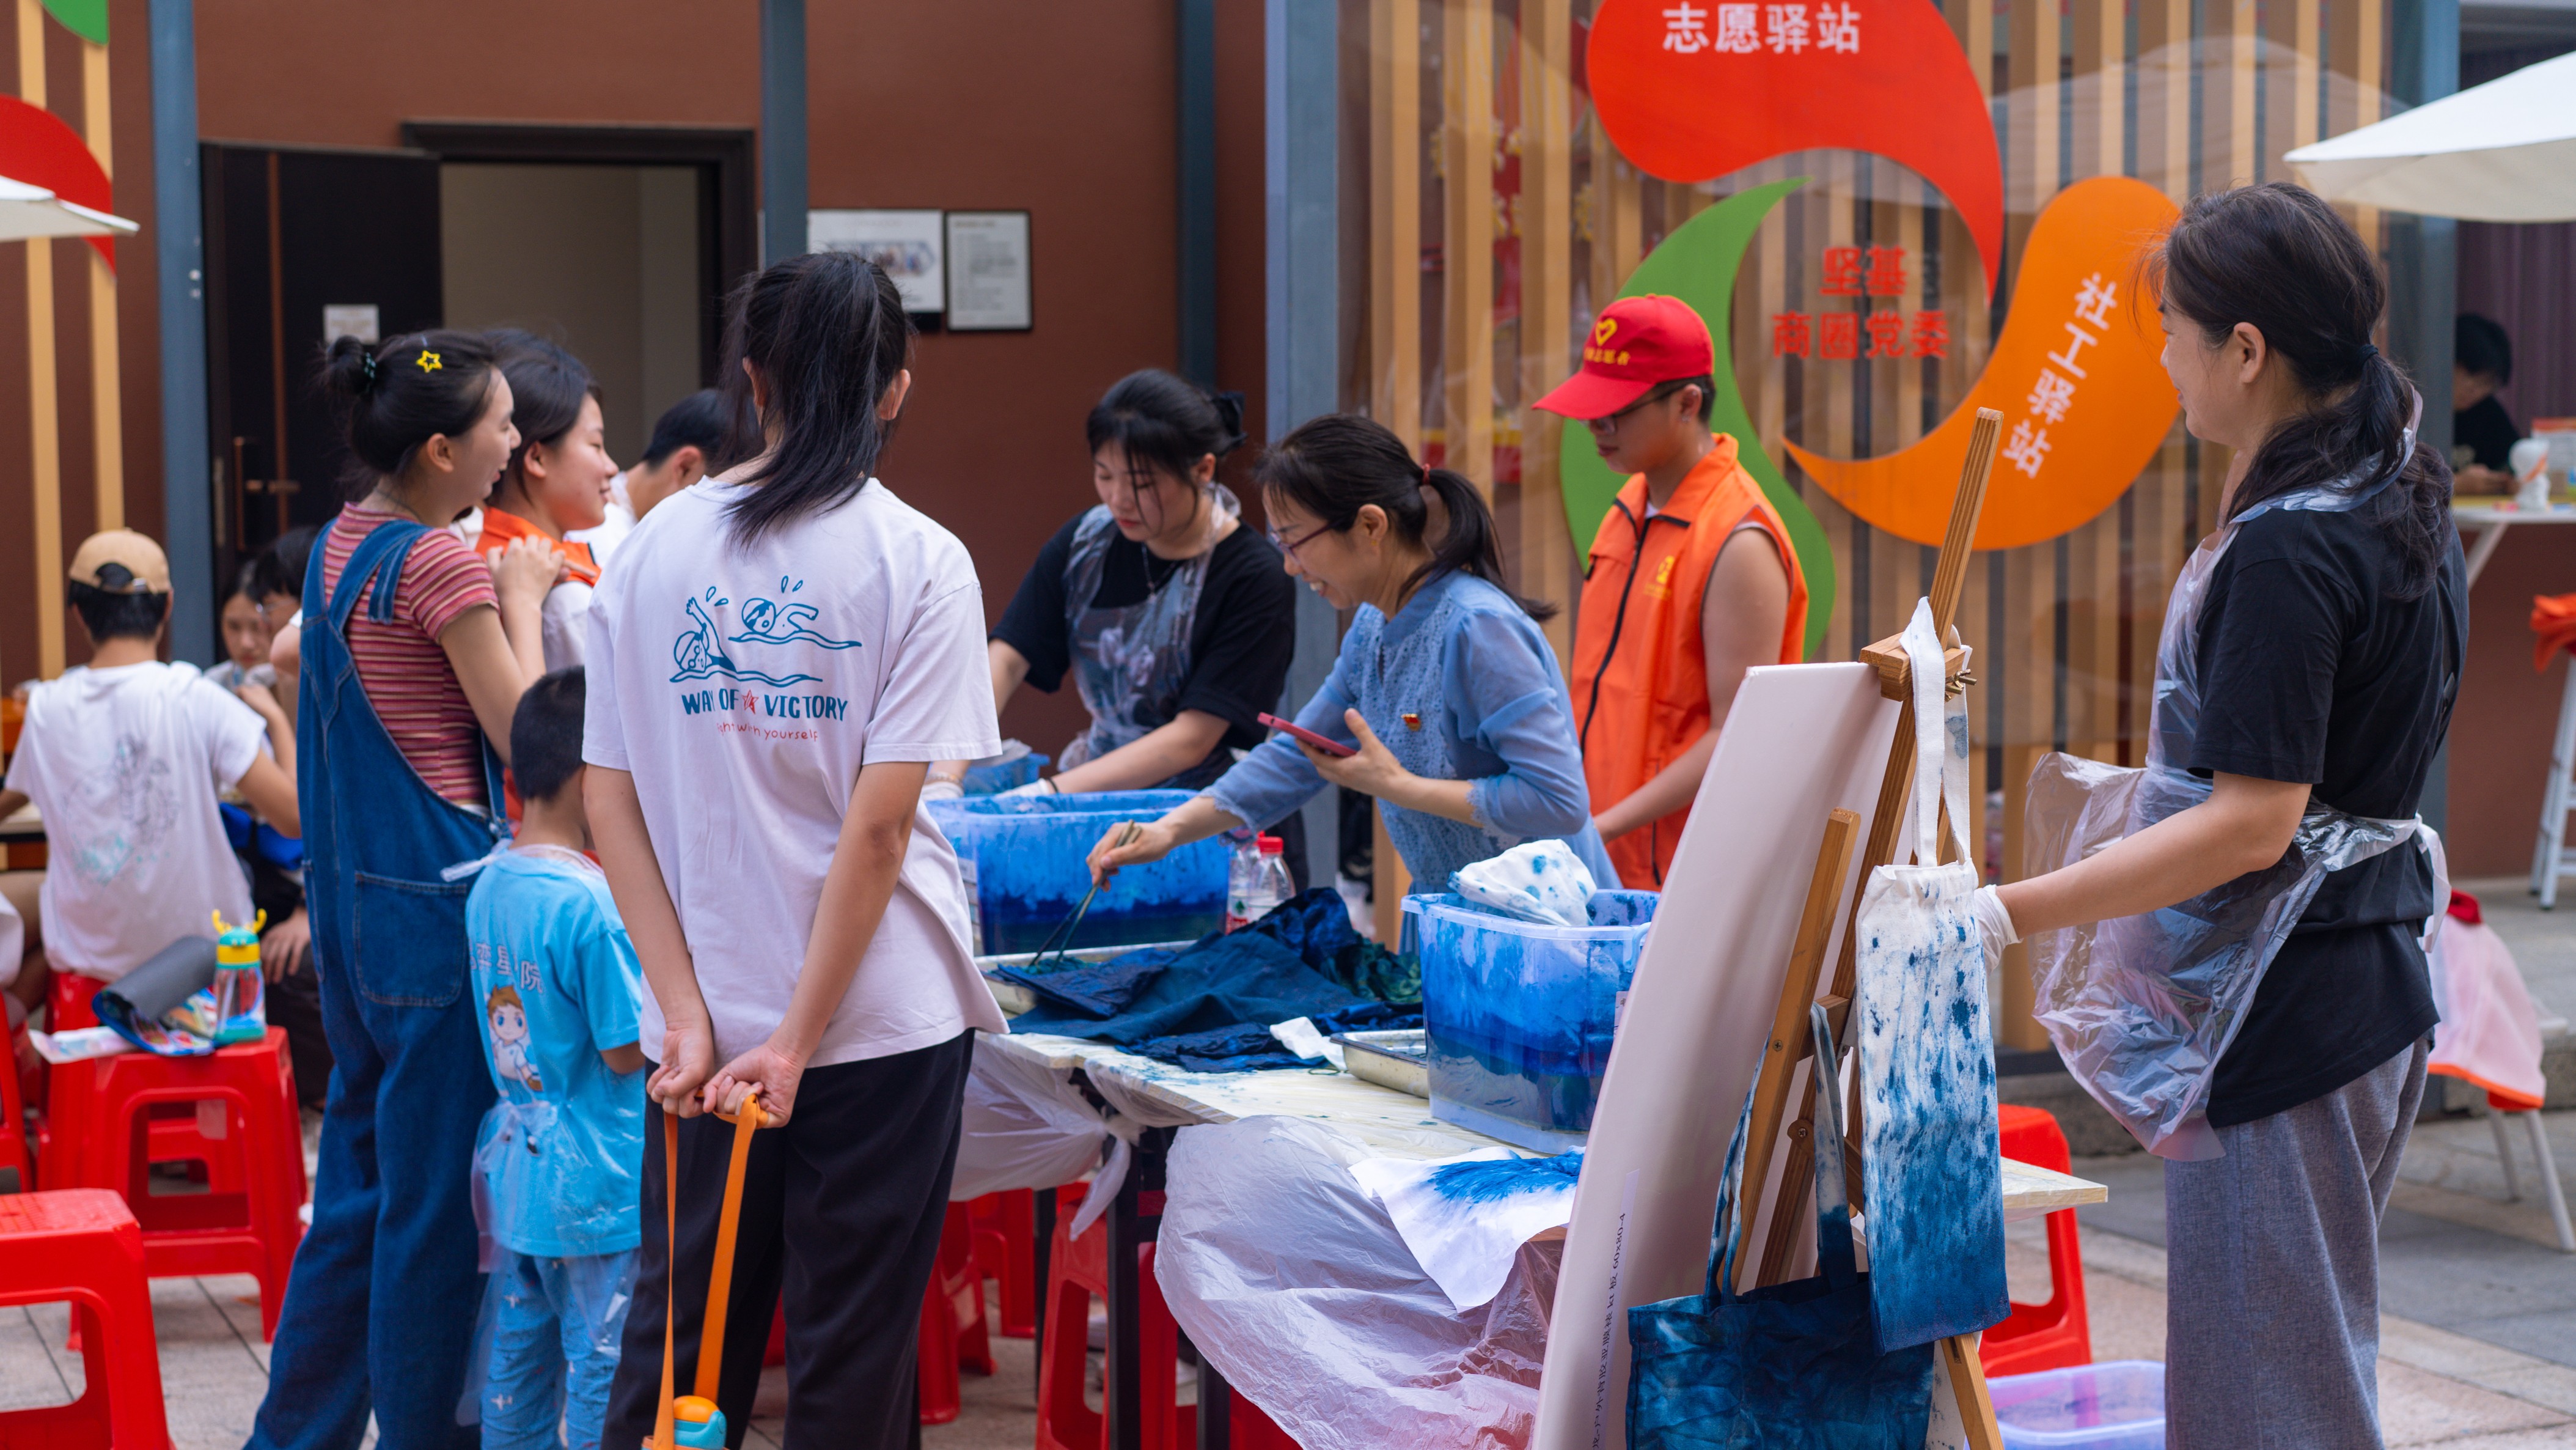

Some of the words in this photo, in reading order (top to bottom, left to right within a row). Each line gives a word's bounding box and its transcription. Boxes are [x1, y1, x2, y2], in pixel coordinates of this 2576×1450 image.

[1662, 2, 1862, 54] 志愿驿站
[1819, 246, 1907, 298] 坚基
[1772, 311, 1950, 359] 商圈党委
[2002, 273, 2118, 479] 社工驿站
[681, 691, 715, 715] WAY
[719, 688, 739, 710] OF
[764, 694, 848, 721] VICTORY
[764, 729, 818, 742] yourself
